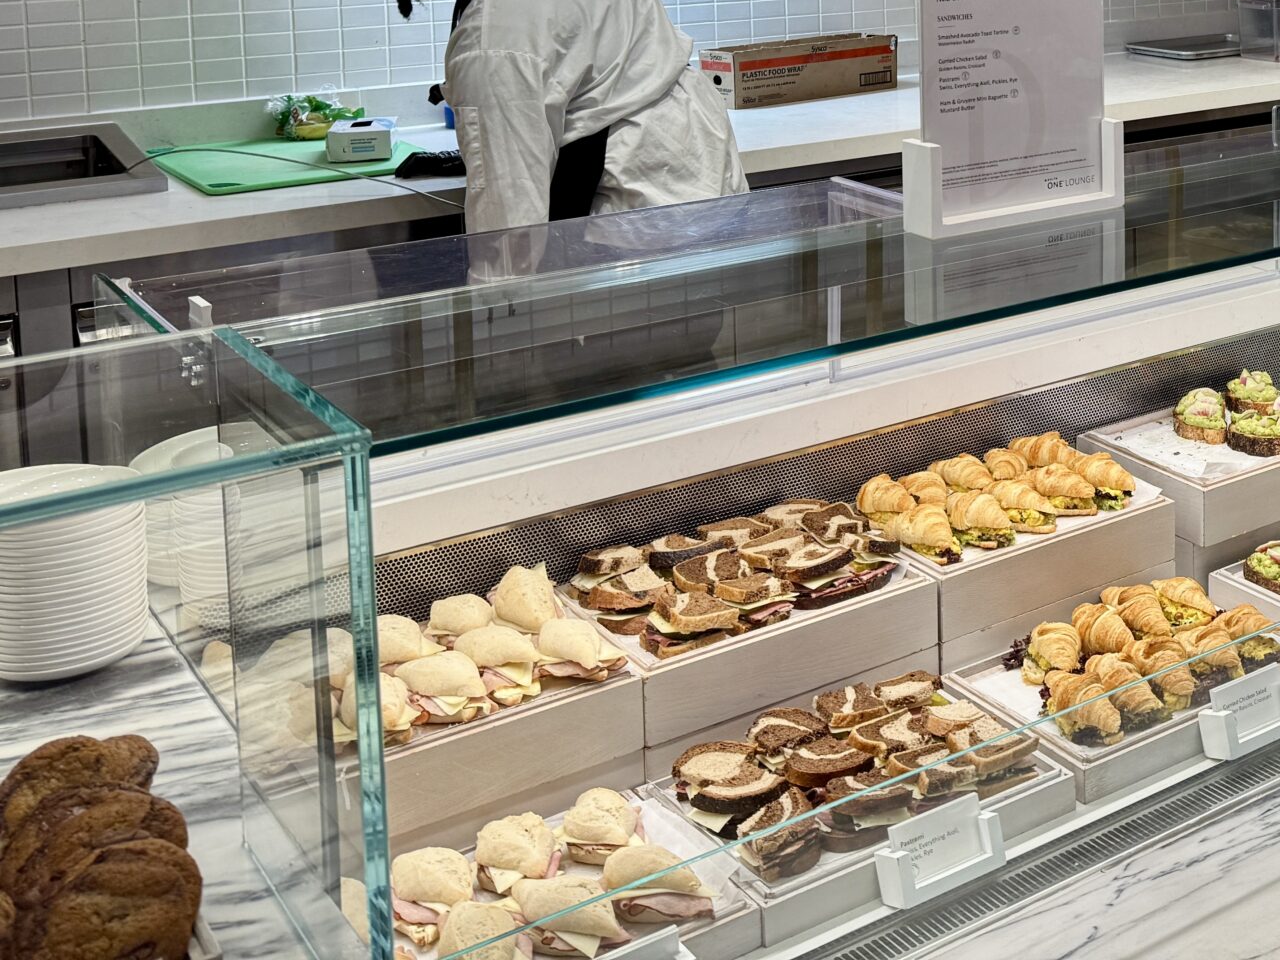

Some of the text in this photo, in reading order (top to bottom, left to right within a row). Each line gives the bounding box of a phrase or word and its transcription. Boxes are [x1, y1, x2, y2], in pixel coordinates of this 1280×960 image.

[937, 14, 973, 22] SANDWICHES
[811, 46, 827, 54] Sysco
[710, 53, 722, 62] Sysco
[742, 70, 768, 79] PLASTIC
[1048, 180, 1064, 190] ONE
[1065, 175, 1096, 187] LOUNGE
[1223, 688, 1266, 710] Curried Chicken Salad
[900, 834, 924, 848] Pastrami
[919, 834, 946, 849] Everything
